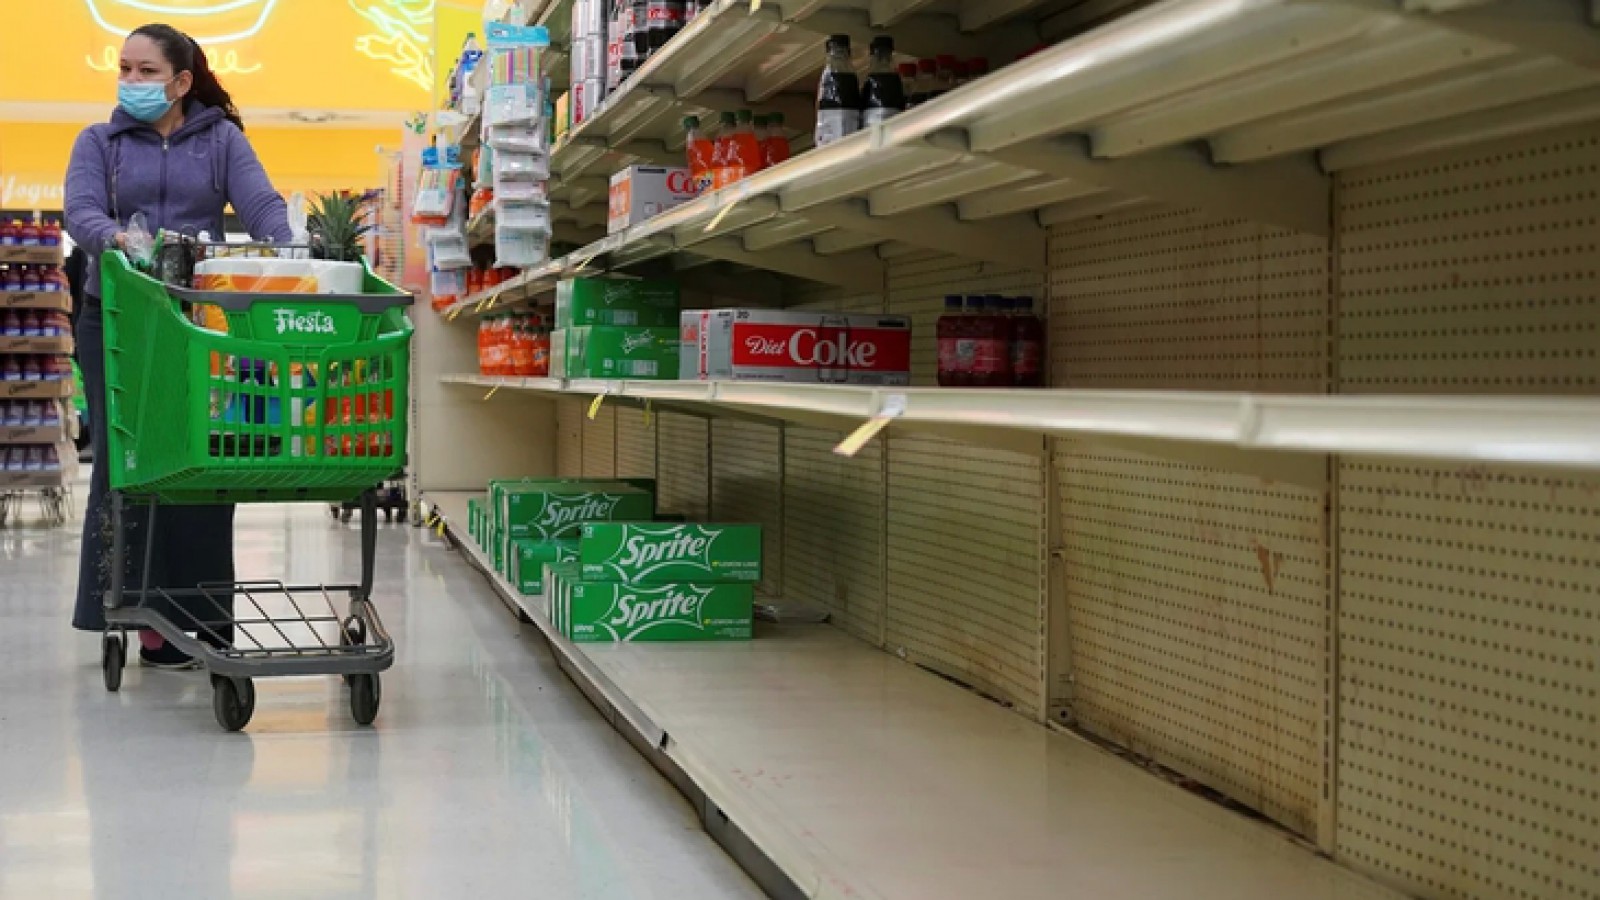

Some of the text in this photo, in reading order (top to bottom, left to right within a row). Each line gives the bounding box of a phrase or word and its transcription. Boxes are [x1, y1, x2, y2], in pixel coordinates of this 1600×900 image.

[272, 307, 335, 335] Fiesta
[744, 335, 785, 355] Diet
[788, 328, 877, 368] Coke
[541, 498, 610, 527] Sprite
[620, 532, 706, 569] Sprite
[611, 590, 698, 628] Sprite
